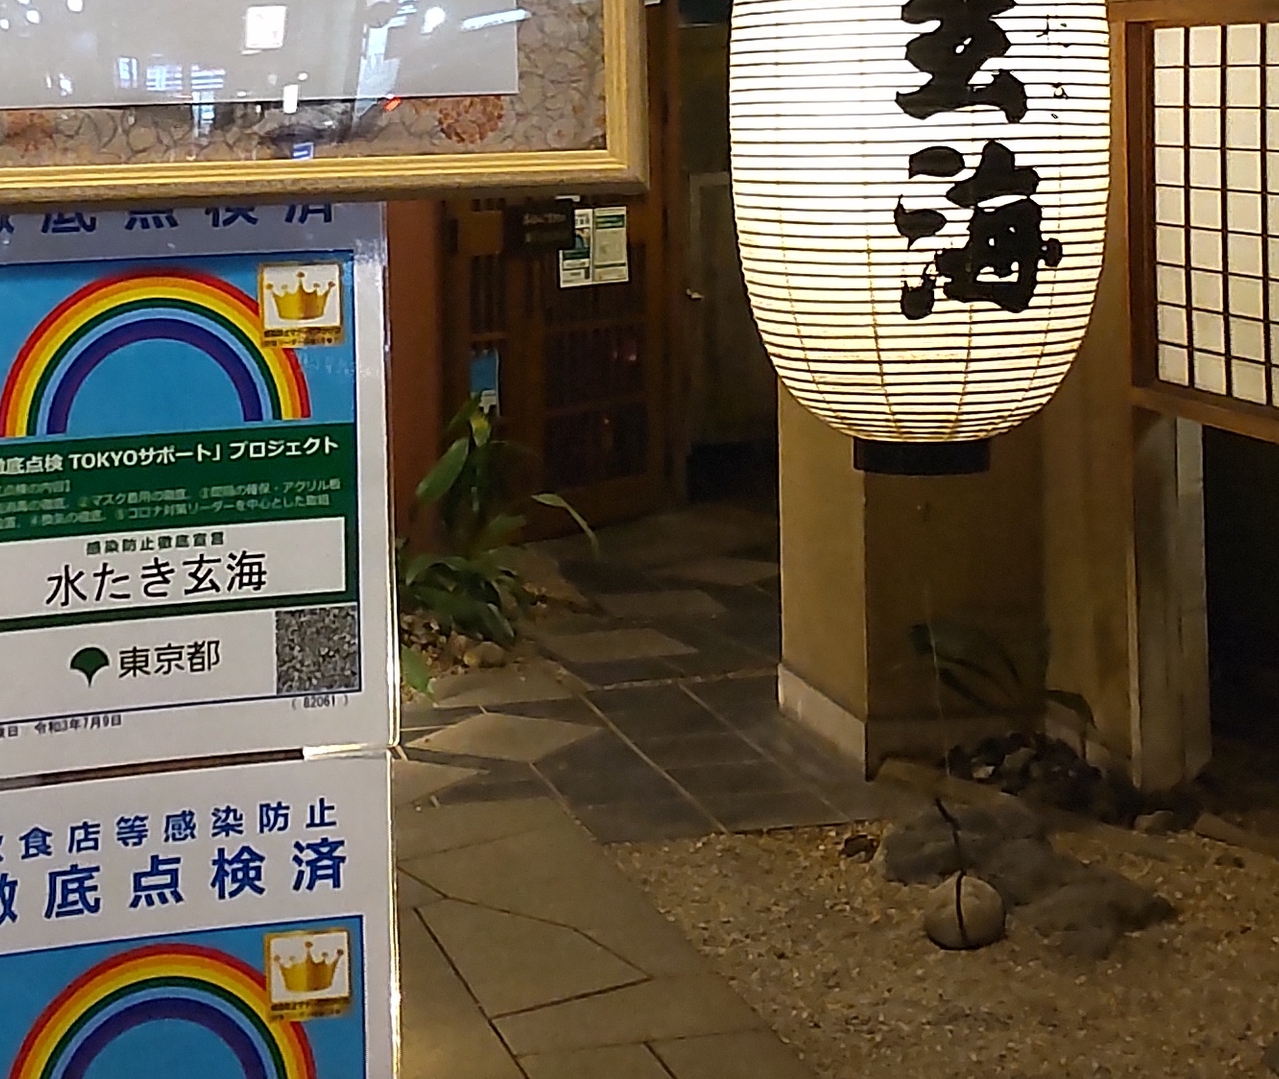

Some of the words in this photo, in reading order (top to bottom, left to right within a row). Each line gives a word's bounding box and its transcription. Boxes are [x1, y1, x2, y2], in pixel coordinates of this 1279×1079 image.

[67, 442, 222, 470] TOKYOサポート」
[229, 435, 340, 460] プロジェクト
[45, 550, 268, 608] 水たき玄海
[117, 639, 222, 680] 東京都
